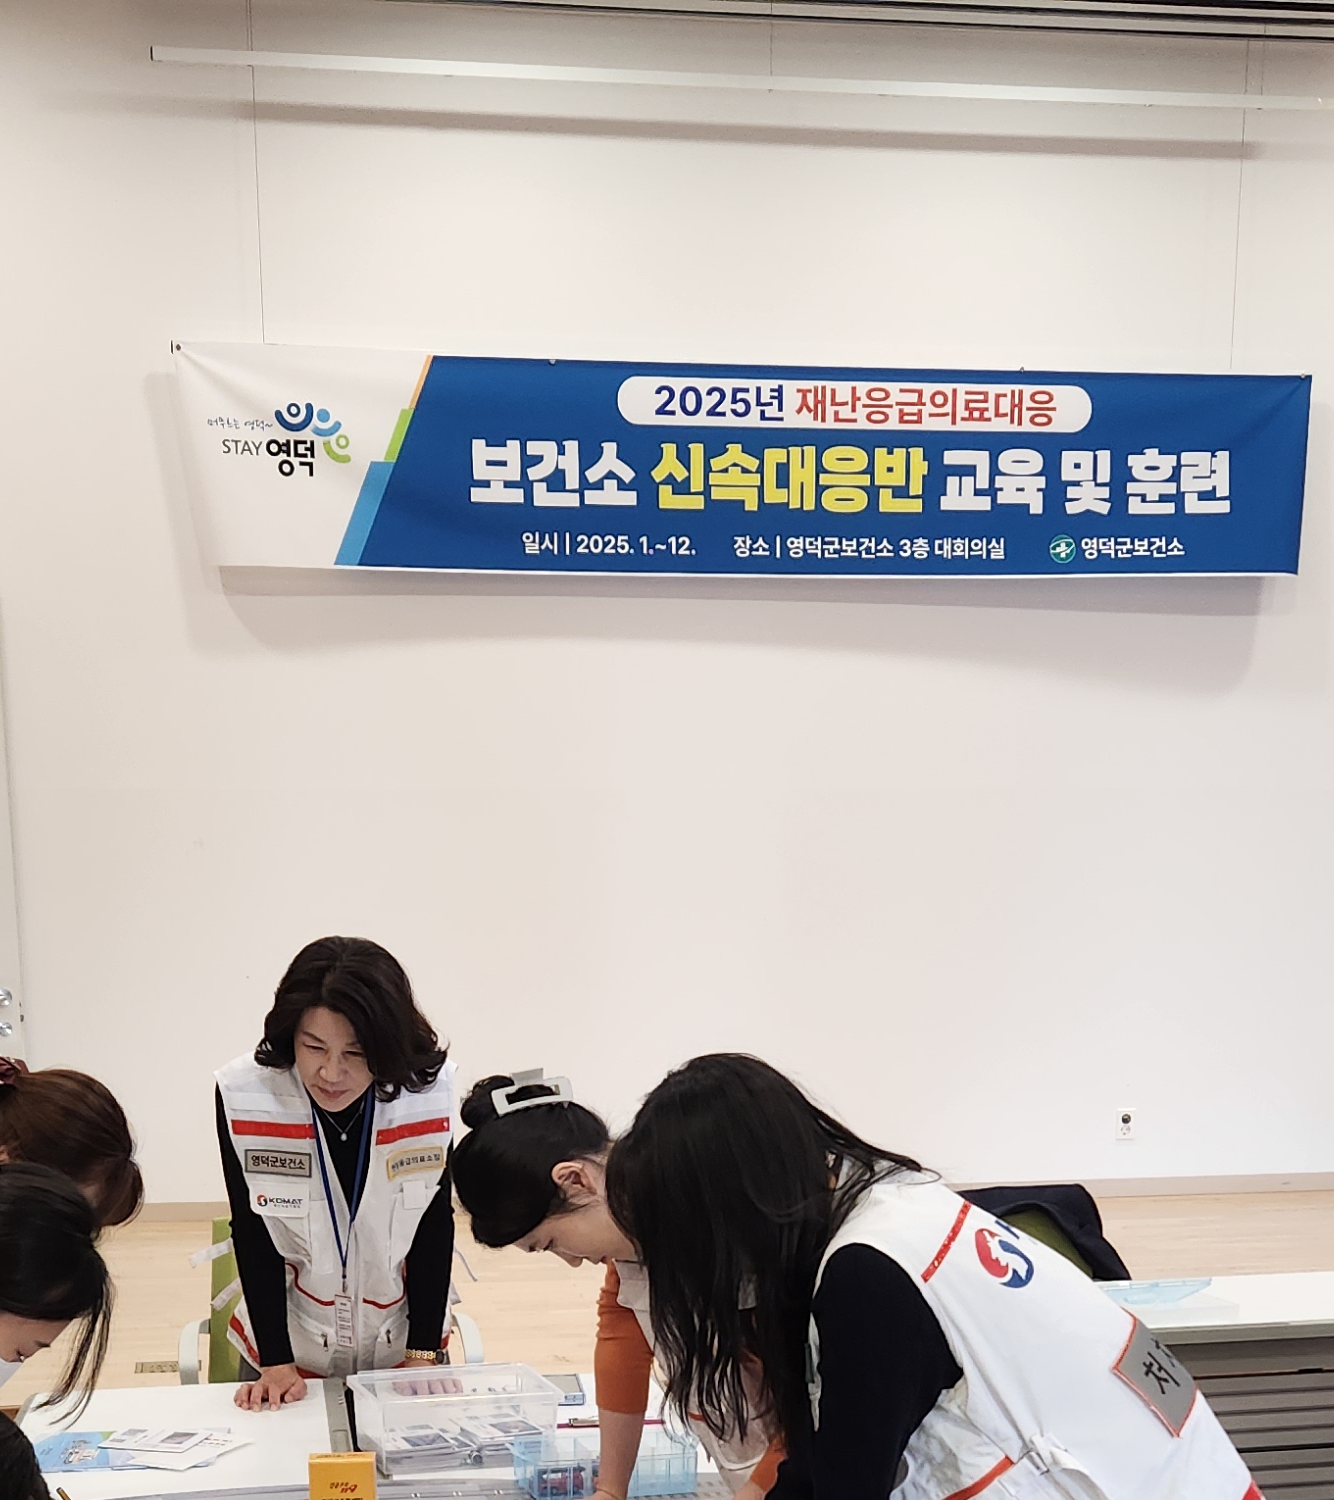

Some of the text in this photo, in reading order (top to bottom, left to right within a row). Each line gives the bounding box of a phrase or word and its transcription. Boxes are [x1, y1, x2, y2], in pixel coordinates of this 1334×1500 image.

[653, 384, 1057, 428] 2025년 재난응급의료대응
[222, 438, 315, 477] STAY 영덕
[470, 438, 1231, 516] 보건소 신속대응반 교육 및 훈련
[521, 532, 558, 555] 일시
[733, 536, 1005, 560] 장소 영덕군보건소 3층 대회의실
[1081, 537, 1185, 560] 영덕군보건소
[250, 1155, 306, 1171] 영덕군보건소
